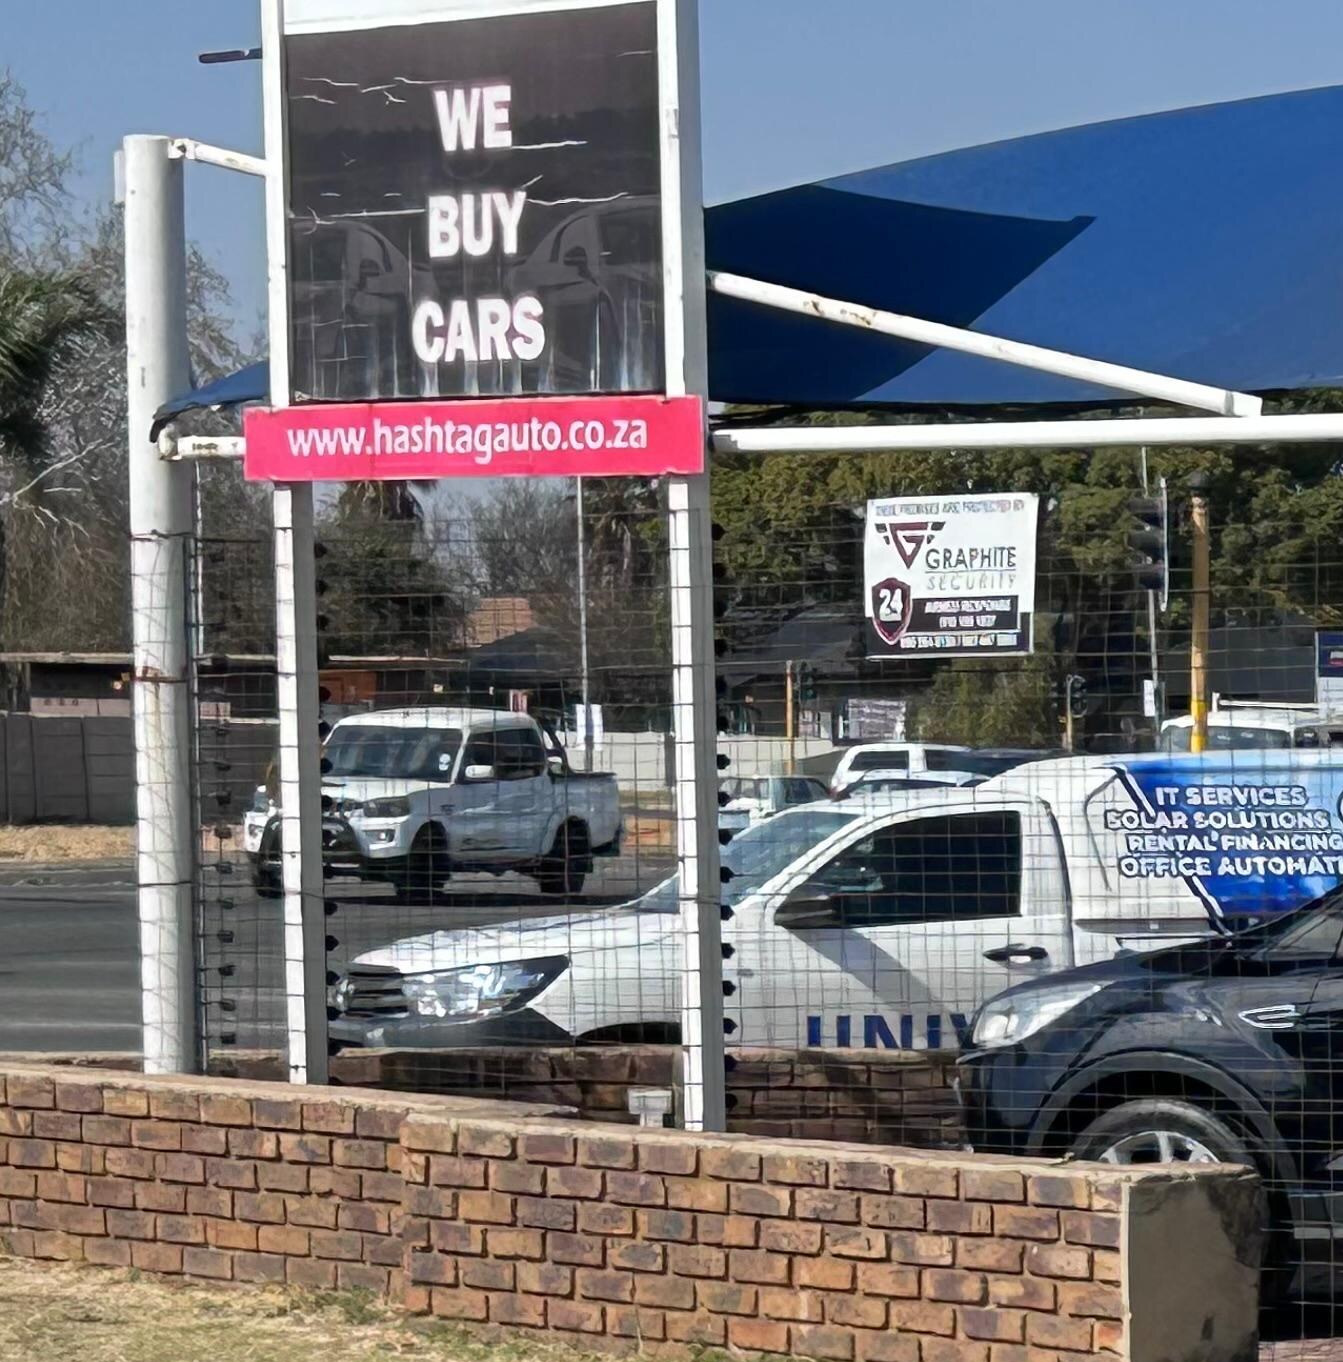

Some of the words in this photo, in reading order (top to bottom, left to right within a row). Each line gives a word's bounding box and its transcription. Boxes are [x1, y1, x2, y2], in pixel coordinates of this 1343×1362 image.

[434, 85, 512, 151] WE
[428, 191, 526, 258] BUY
[412, 297, 545, 362] CARS
[286, 416, 648, 465] www.hashtagauto.co.za
[925, 547, 1016, 570] GRAPHITE
[927, 572, 1016, 591] SECURITY
[879, 588, 904, 614] 24
[1155, 787, 1178, 806] IT
[1187, 786, 1307, 806] SERVICES
[1106, 810, 1189, 829] SOLAR
[1194, 810, 1329, 829] SOLUTIONS
[1128, 833, 1216, 852] RENTAL
[1121, 855, 1212, 876] OFFICE
